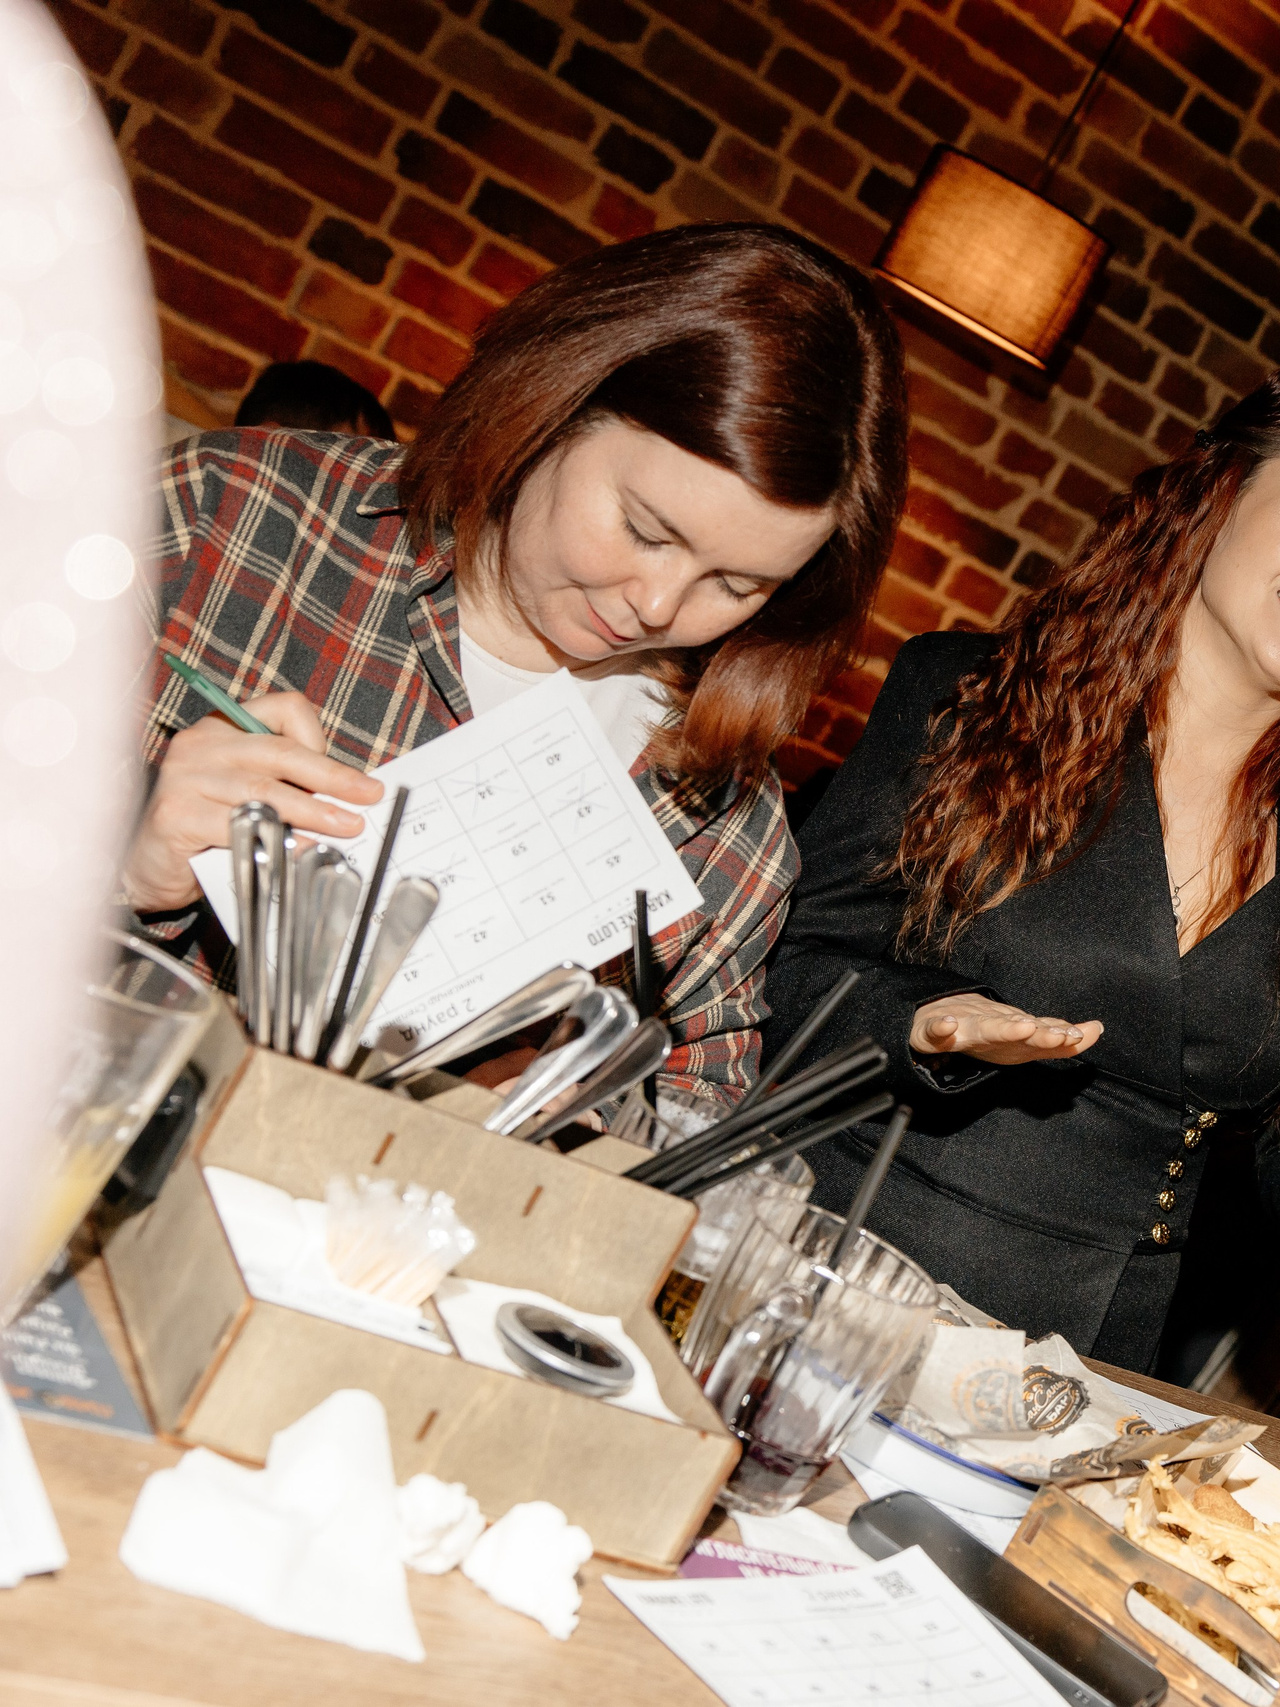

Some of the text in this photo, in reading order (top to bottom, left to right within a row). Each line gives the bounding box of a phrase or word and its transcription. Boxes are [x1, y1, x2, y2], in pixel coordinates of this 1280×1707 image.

[546, 752, 563, 766] 40
[477, 786, 494, 801] 34
[576, 804, 593, 818] 43
[412, 822, 427, 836] 47
[510, 842, 528, 856] 59
[604, 853, 622, 868] 45
[539, 889, 556, 906] 51
[473, 929, 489, 943] 42
[587, 920, 619, 946] LOTO
[403, 969, 418, 982] 41
[397, 998, 476, 1042] 2 раунд
